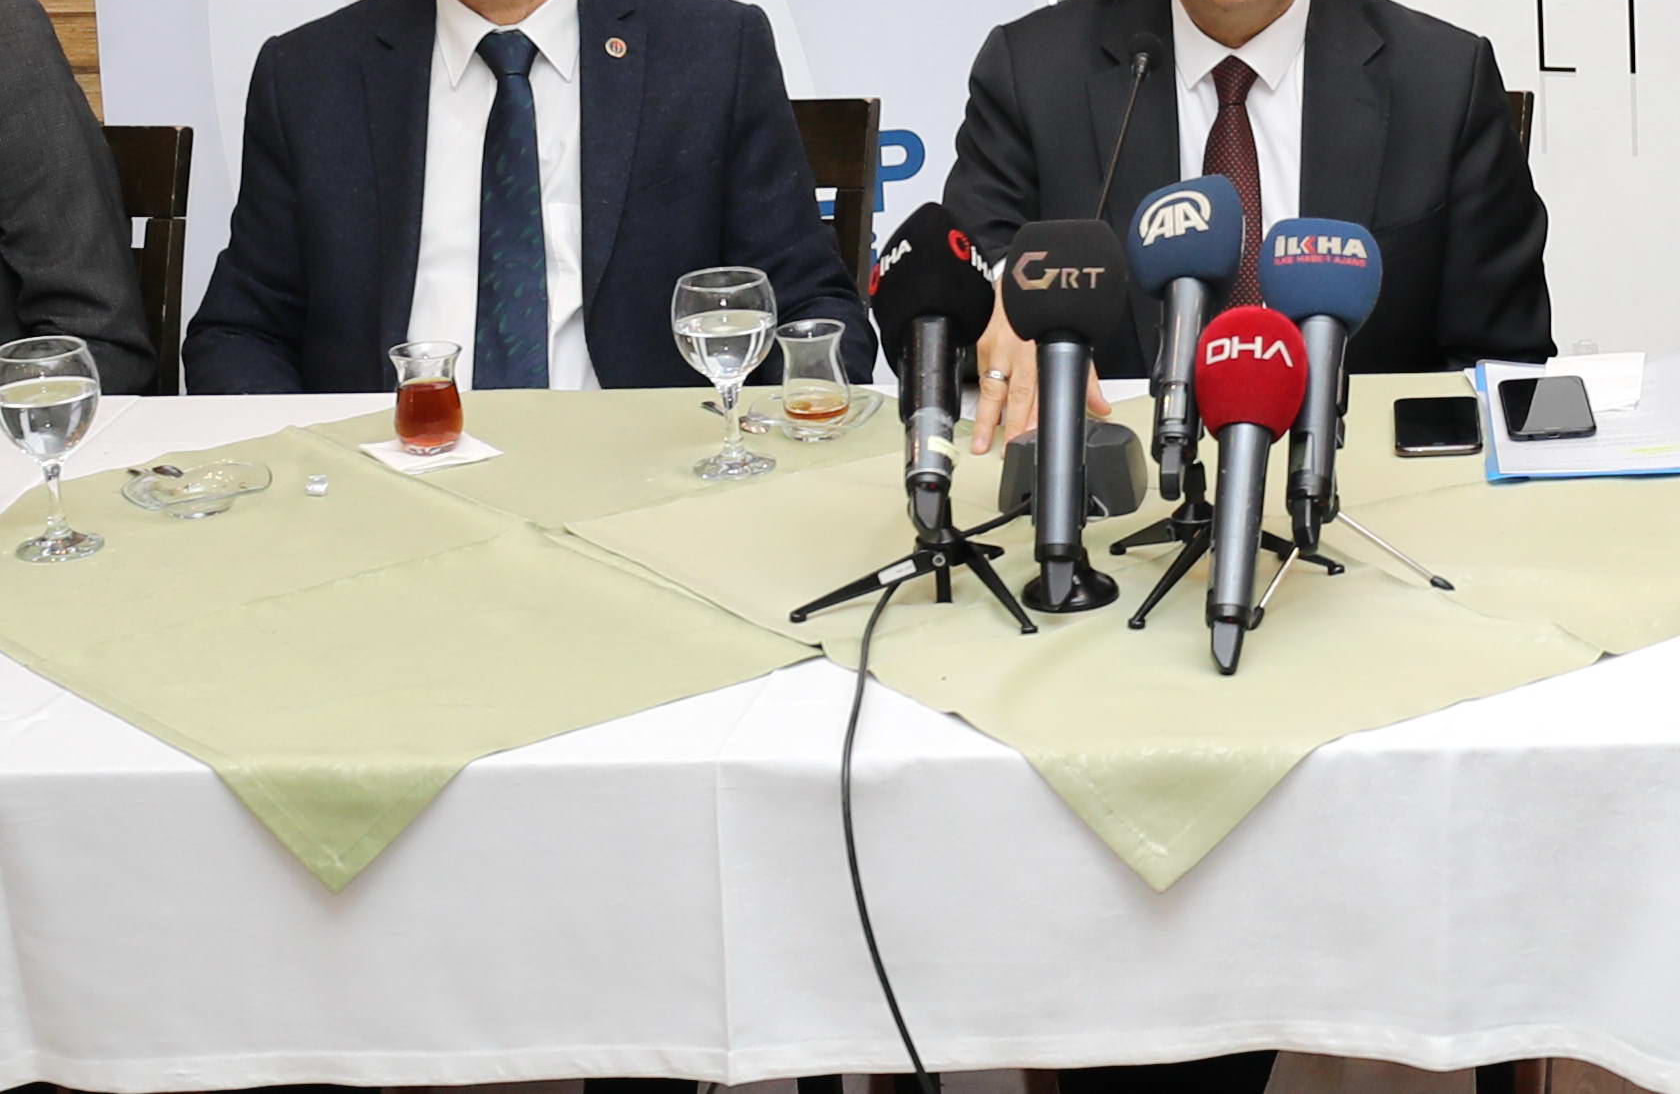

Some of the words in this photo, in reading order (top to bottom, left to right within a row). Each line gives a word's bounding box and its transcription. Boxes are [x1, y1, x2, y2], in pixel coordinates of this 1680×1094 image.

[1141, 196, 1210, 247] AA
[1012, 251, 1105, 291] GRT
[1206, 335, 1294, 368] DHA
